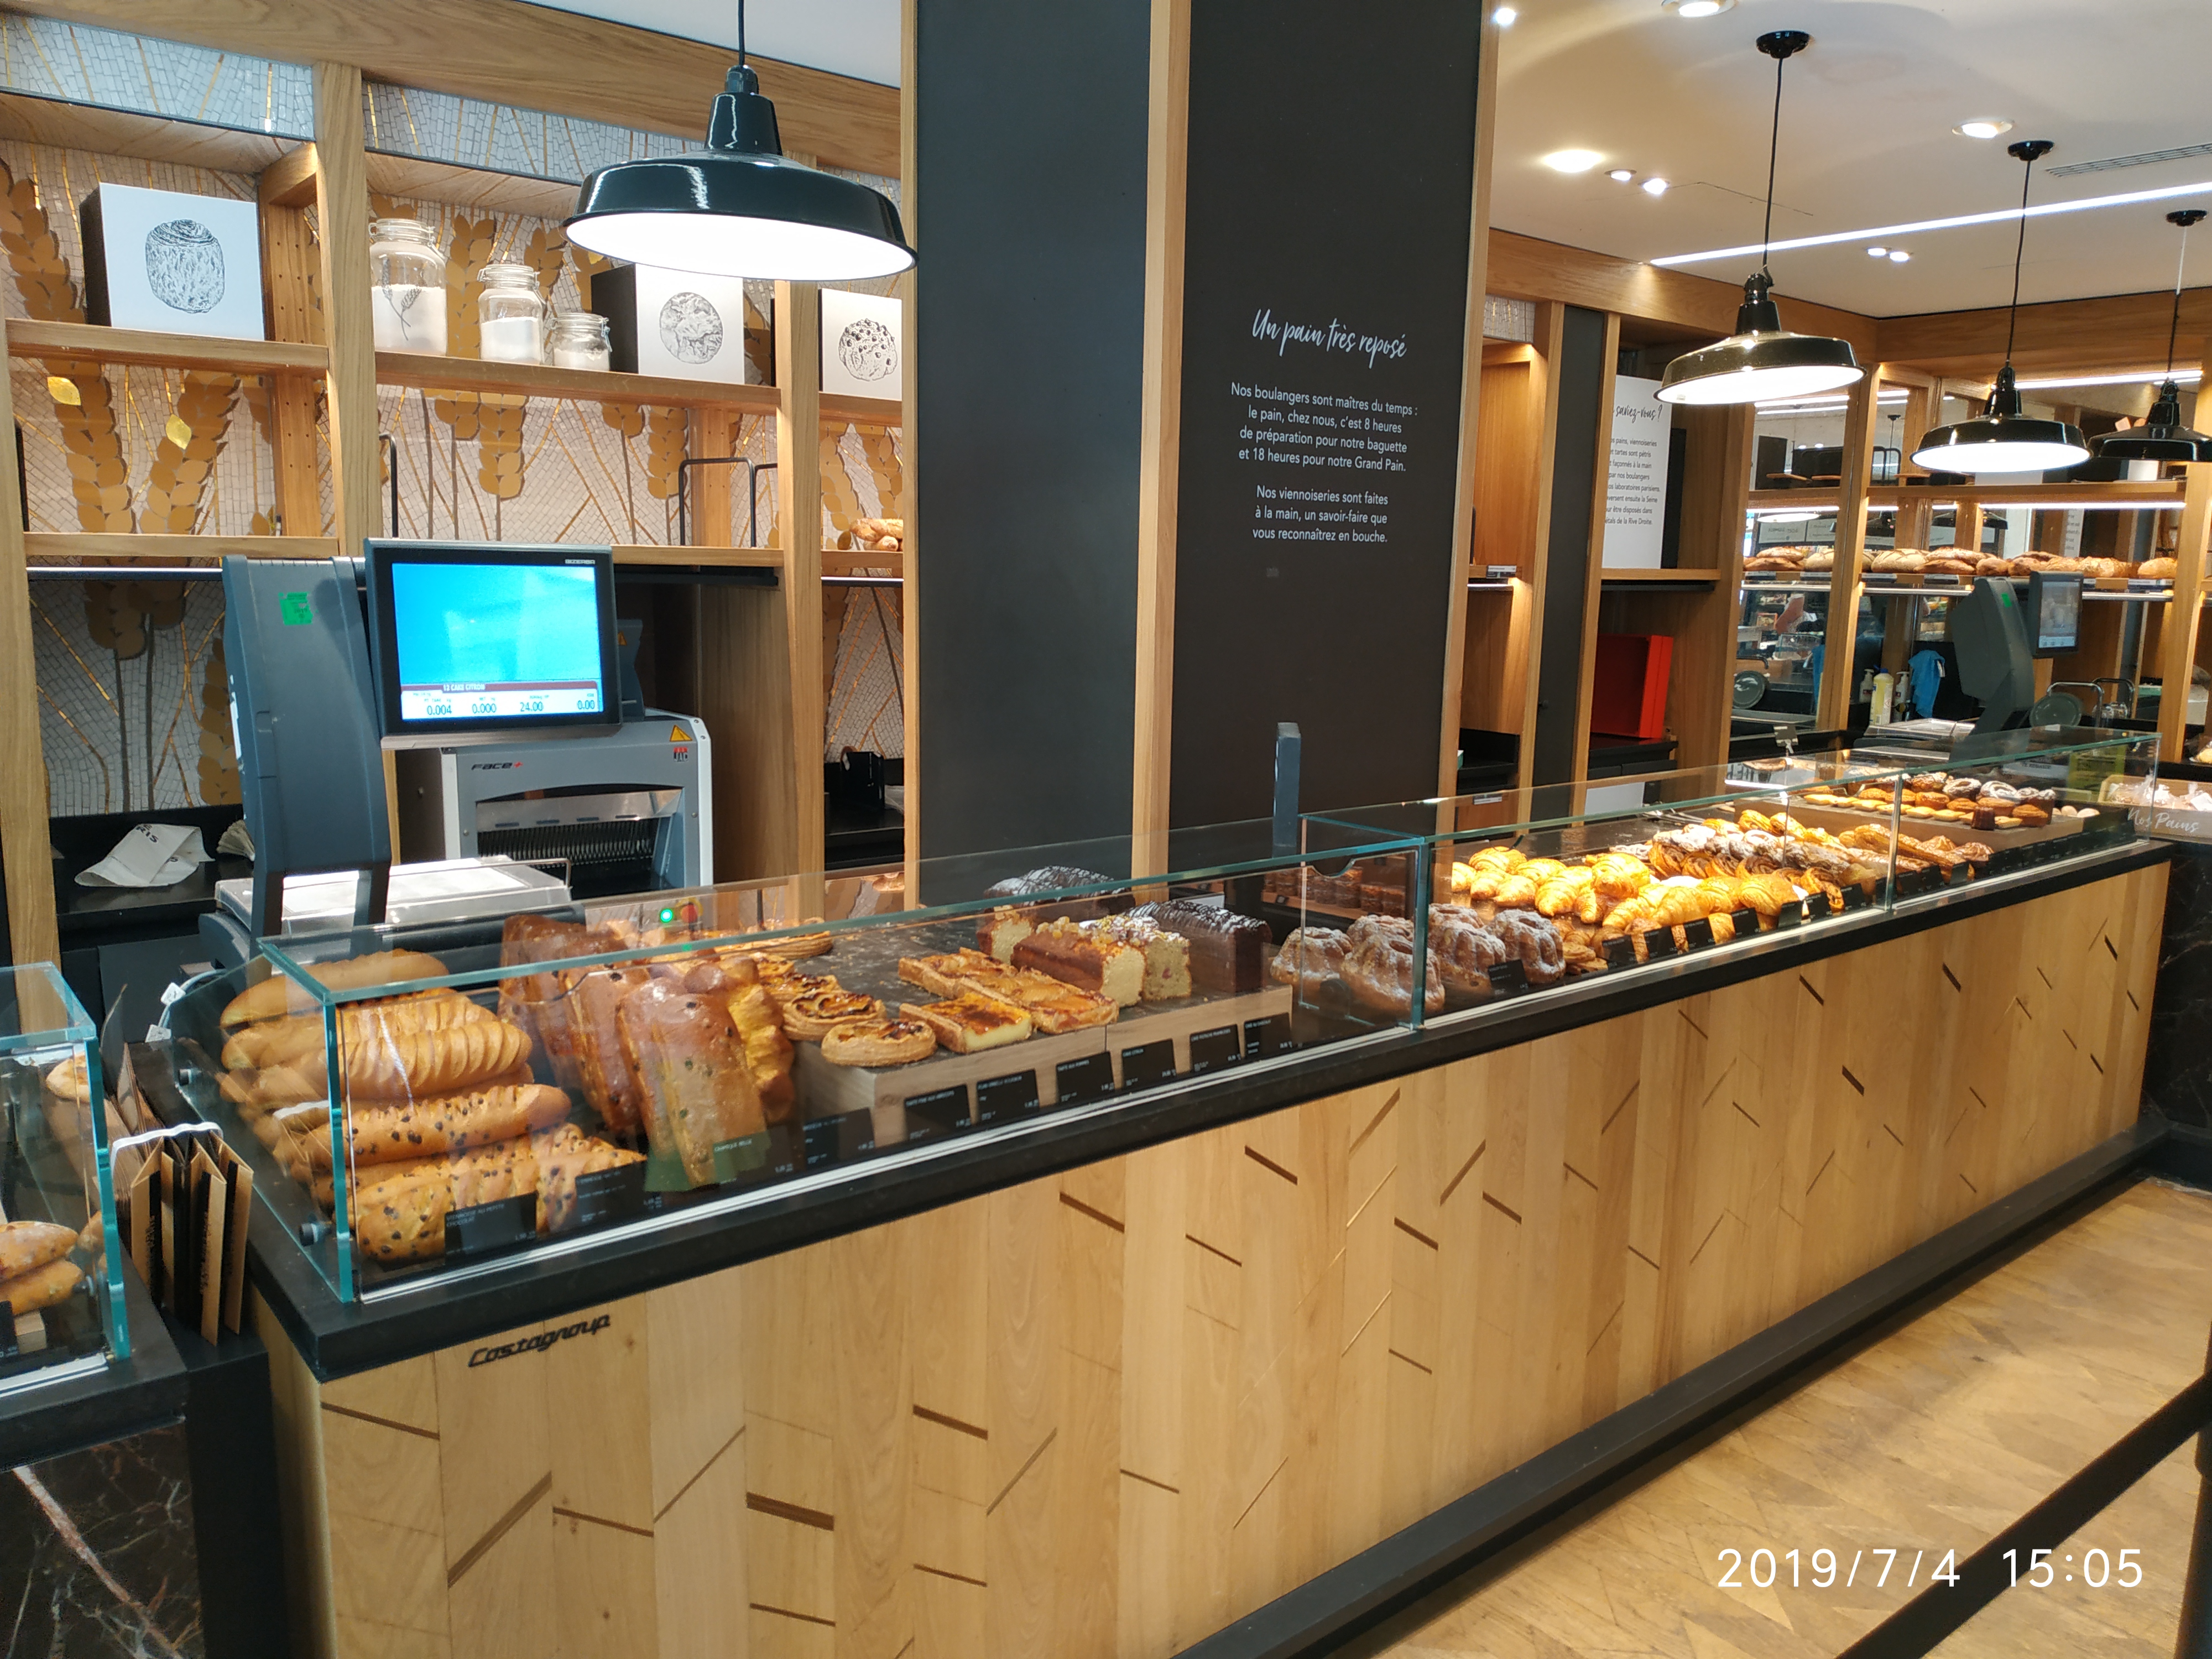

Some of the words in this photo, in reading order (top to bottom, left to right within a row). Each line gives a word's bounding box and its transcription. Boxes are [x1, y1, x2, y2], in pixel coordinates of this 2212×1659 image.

[1251, 309, 1281, 340] Un
[1279, 321, 1326, 357] pain
[1326, 318, 1355, 352] très
[1358, 333, 1407, 369] reposé
[1231, 382, 1252, 397] Nos
[1255, 384, 1310, 406] boulangers
[1312, 395, 1333, 406] sont
[1335, 396, 1369, 411] maîtres
[1371, 399, 1383, 412] du
[1385, 402, 1412, 418] temps
[1248, 404, 1258, 419] le
[1260, 408, 1285, 424] pain,
[1287, 409, 1310, 424] chez
[1312, 416, 1337, 429] nous,
[1340, 416, 1362, 430] c’est
[1364, 418, 1370, 430] 8
[1373, 418, 1402, 434] heures
[1240, 425, 1253, 439] de
[1256, 427, 1313, 445] préparation
[1316, 436, 1338, 448] pour
[1340, 437, 1365, 449] notre
[1367, 437, 1407, 454] baguette
[1630, 439, 1657, 447] viennoiseries
[1239, 448, 1250, 460] et
[1253, 447, 1265, 461] 18
[1267, 447, 1300, 464] heures
[1302, 455, 1326, 467] pour
[1328, 456, 1352, 468] notre
[1354, 456, 1383, 470] Grand
[1385, 458, 1406, 471] Pain.
[1613, 459, 1632, 468] façonnés
[1626, 472, 1650, 481] boulangers
[1256, 484, 1276, 499] Nos
[1279, 487, 1340, 502] viennoiseries
[1342, 493, 1362, 504] sont
[1364, 491, 1388, 505] faites
[1255, 505, 1261, 518] à
[1264, 505, 1272, 519] la
[1275, 507, 1301, 522] main,
[1305, 511, 1316, 520] un
[1318, 509, 1368, 523] savoir-faire
[1370, 514, 1387, 526] que
[1253, 529, 1275, 539] vous
[1278, 528, 1336, 541] reconnaîtrez
[1338, 532, 1350, 541] en
[1352, 529, 1387, 542] bouche.
[427, 705, 452, 715] 0.004
[472, 703, 497, 714] 0.000
[520, 701, 544, 712] 24.00
[577, 700, 596, 710] 0.00
[2155, 812, 2200, 833] Pains
[468, 1314, 611, 1368] Costagroup
